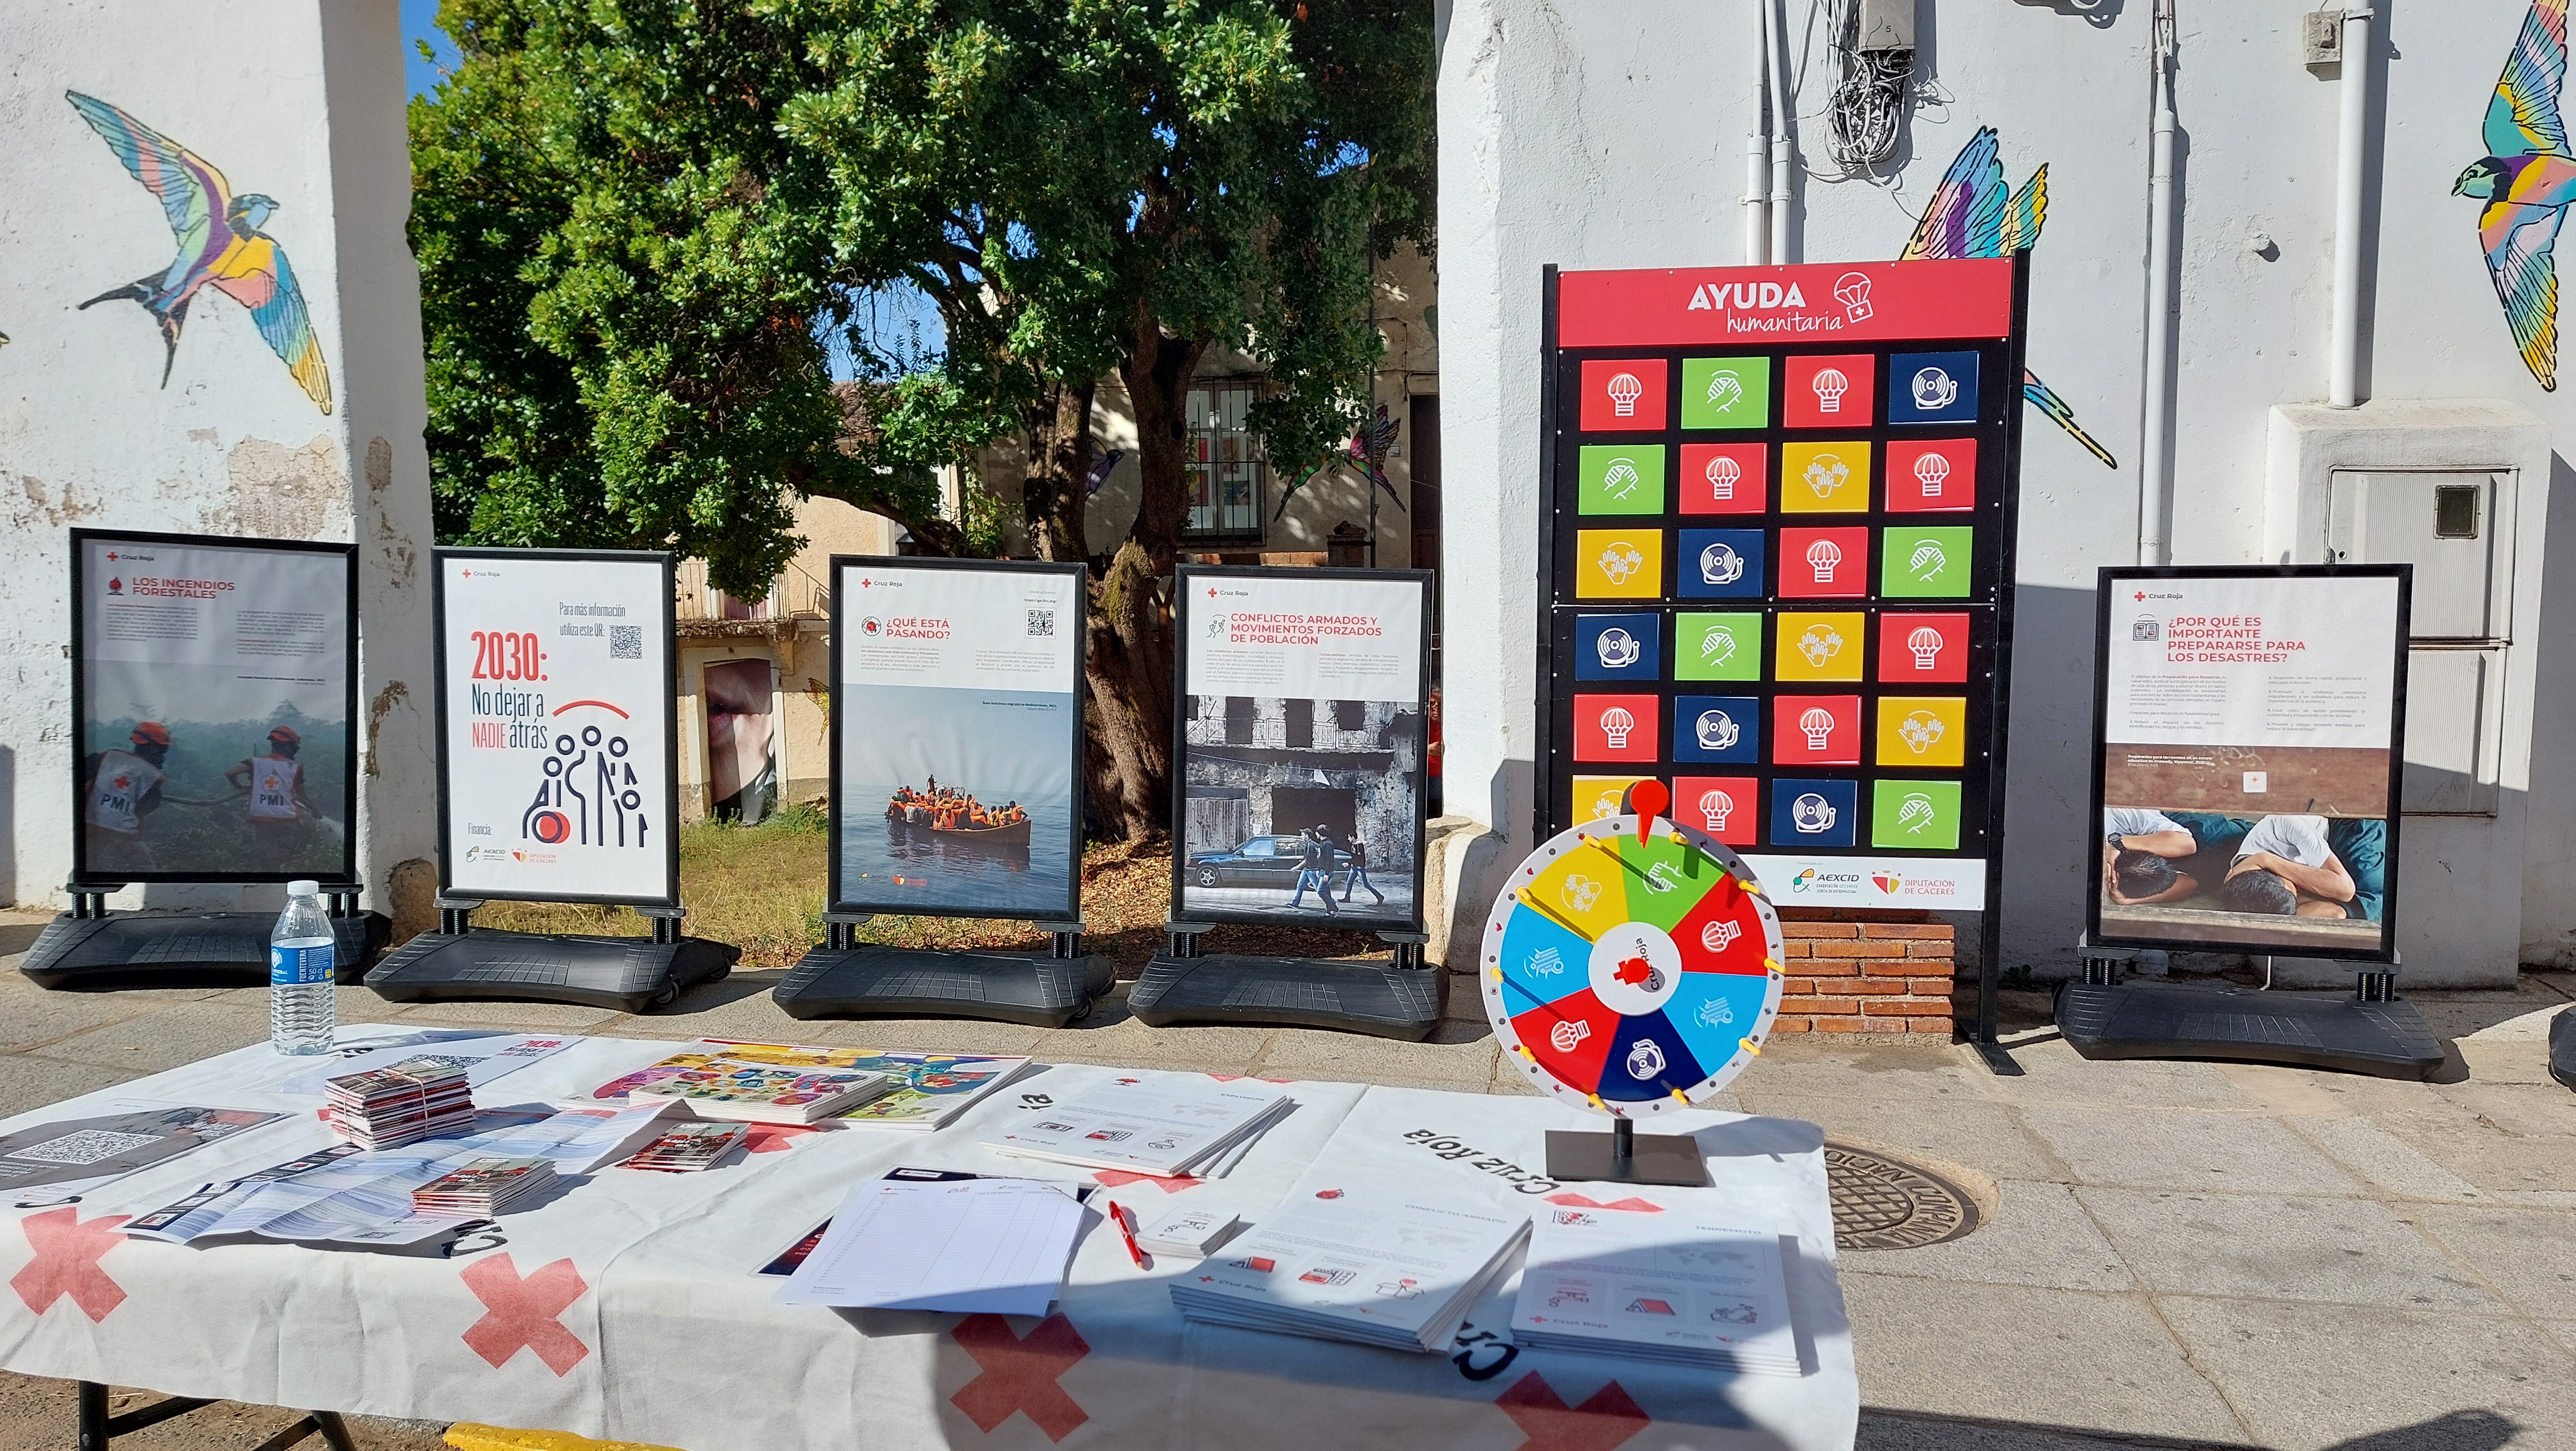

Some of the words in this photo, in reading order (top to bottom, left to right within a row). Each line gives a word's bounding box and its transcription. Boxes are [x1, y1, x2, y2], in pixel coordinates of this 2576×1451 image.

[1687, 281, 1807, 310] AYUDA
[1727, 306, 1845, 333] humanitaria
[133, 577, 158, 586] LOS
[162, 579, 235, 591] INCENDIOS
[133, 587, 216, 599] FORESTALES
[559, 602, 573, 616] Para
[574, 603, 587, 616] más
[588, 603, 626, 617] información
[886, 616, 918, 629] ¿QUÉ
[921, 617, 950, 629] ESTÁ
[1231, 613, 1304, 623] CONFLICTOS
[1307, 615, 1367, 625] ARMADOS
[1370, 617, 1378, 625] Y
[2168, 617, 2206, 628] ¿POR
[2210, 615, 2240, 627] QUÉ
[2245, 617, 2261, 626] ES
[560, 622, 578, 636] utiliza
[579, 625, 593, 636] este
[594, 622, 606, 637] QR:
[886, 629, 950, 640] PASANDO?
[1231, 624, 1314, 634] MOVIMIENTOS
[1317, 626, 1382, 636] FORZADOS
[2168, 629, 2261, 639] IMPORTANTE
[1231, 634, 1246, 642] DE
[1250, 632, 1319, 645] POBLACIÓN
[2168, 641, 2262, 651] PREPARARSE
[2266, 641, 2306, 651] PARA
[471, 631, 548, 681] 2030:
[2167, 653, 2194, 663] LOS
[2198, 653, 2288, 663] DESASTRES?
[472, 683, 490, 715] No
[495, 683, 532, 723] dejar
[536, 693, 544, 717] a
[472, 723, 507, 749] NADIE
[509, 718, 548, 749] atrás
[100, 793, 131, 813] PMI
[259, 793, 284, 806] PMI
[468, 822, 493, 835] Financia:
[1817, 874, 1860, 882] AEXCID
[1905, 878, 1955, 888] DIPUTACIÓN
[1917, 887, 1955, 895] CÁCERES
[1403, 1128, 1486, 1161] Roja
[1470, 1156, 1561, 1194] Cruz
[1405, 1204, 1460, 1216] CONFLICTO
[1461, 1213, 1507, 1223] ARMADO
[1695, 1225, 1762, 1235] TERREMOTO
[1243, 1284, 1266, 1292] Roja
